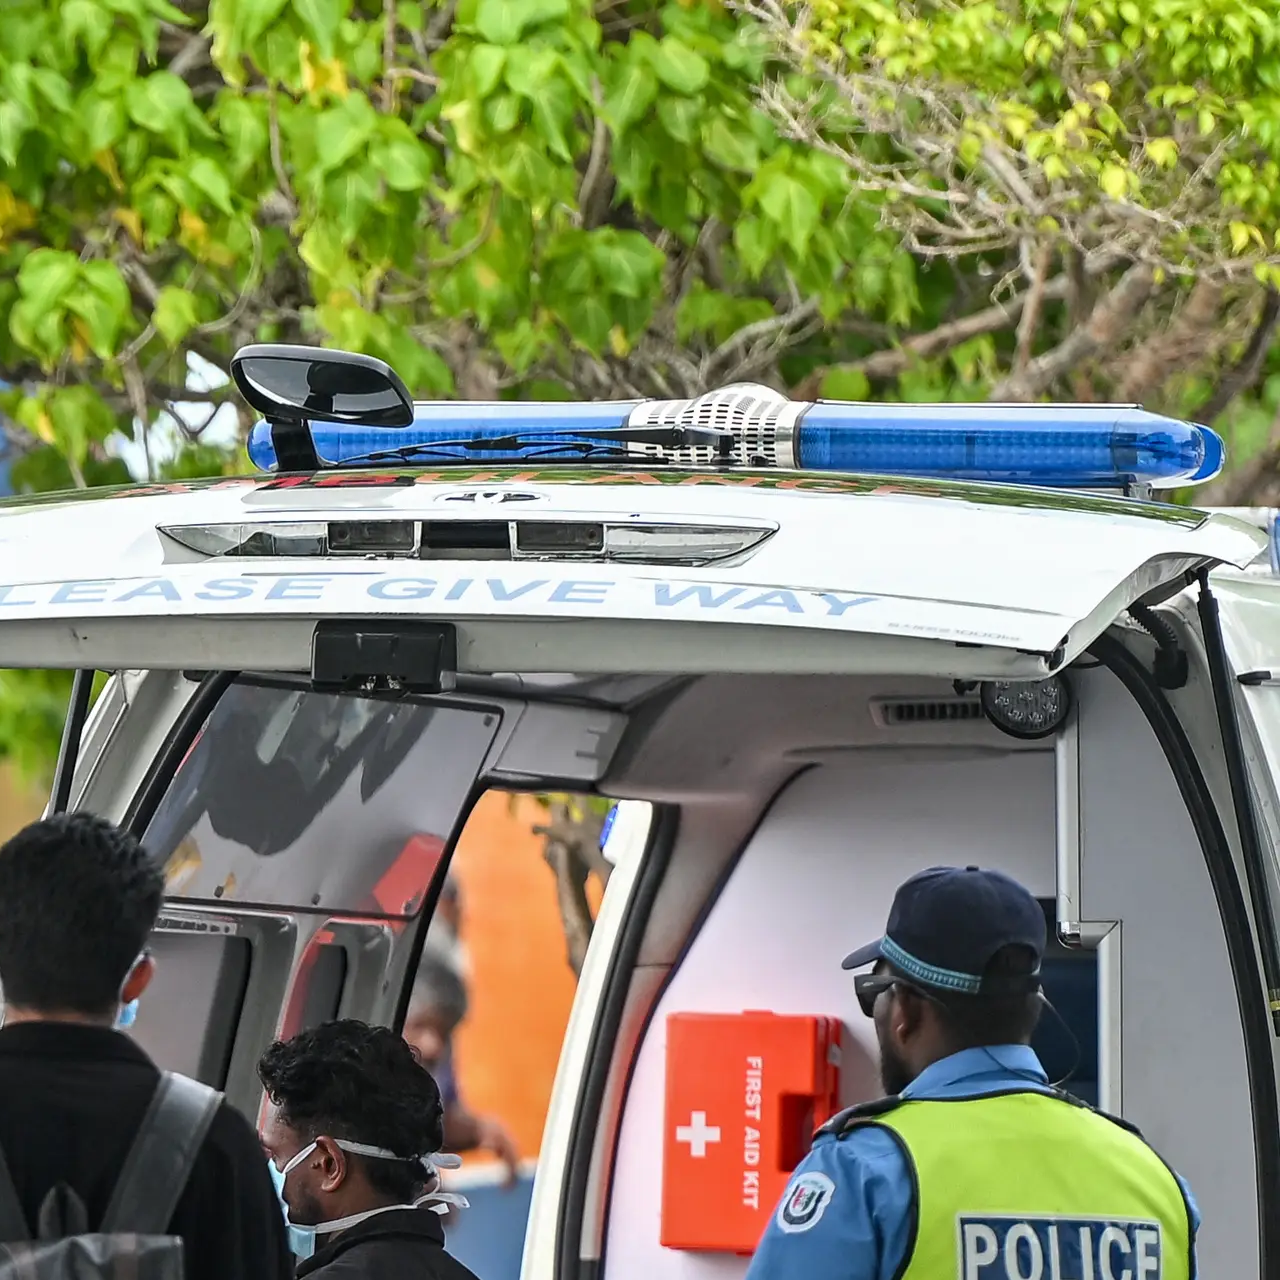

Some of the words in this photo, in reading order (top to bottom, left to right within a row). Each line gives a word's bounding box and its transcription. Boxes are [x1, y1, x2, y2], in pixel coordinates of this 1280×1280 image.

[366, 577, 615, 604] GIVE
[653, 582, 880, 616] WAY
[745, 1056, 763, 1122] FIRST
[744, 1127, 761, 1166] AID
[742, 1171, 760, 1211] KIT
